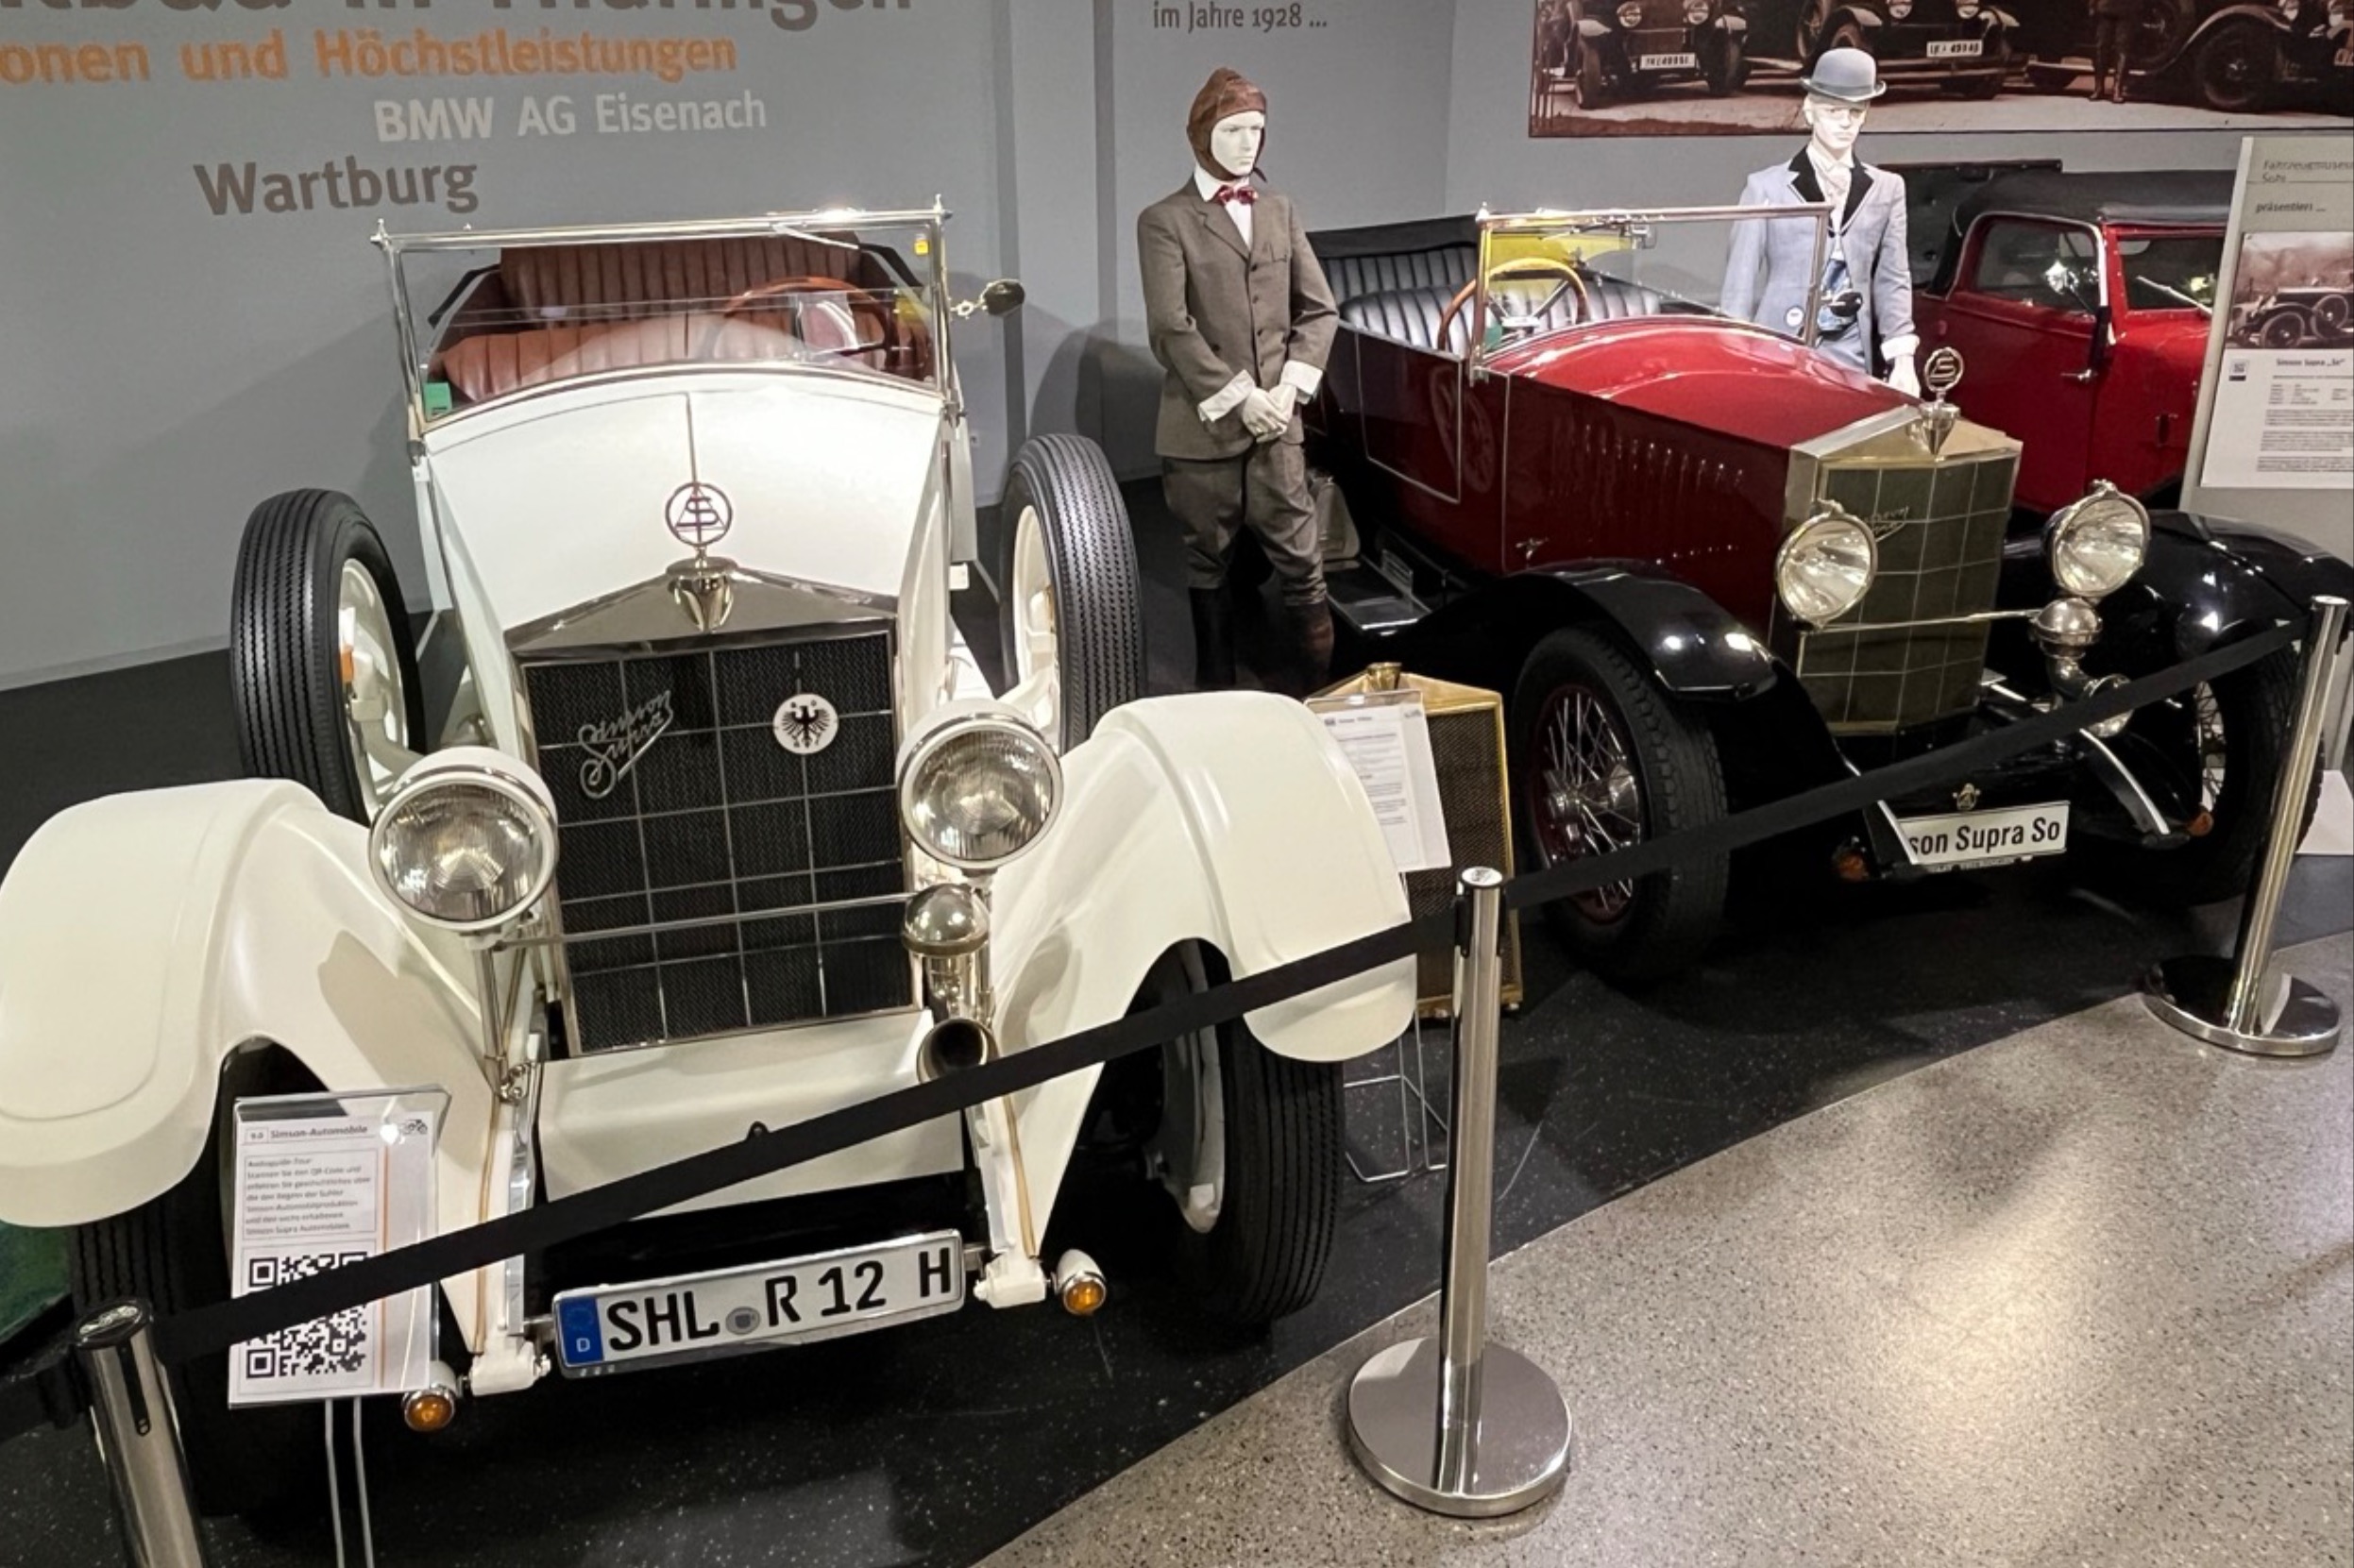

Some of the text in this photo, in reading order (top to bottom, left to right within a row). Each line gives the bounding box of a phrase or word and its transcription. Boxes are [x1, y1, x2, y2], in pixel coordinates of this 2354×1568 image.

[1153, 0, 1180, 29] im
[1188, 0, 1245, 34] Jahre
[1252, 3, 1303, 33] 1928
[0, 25, 737, 85] onen und Höchstleistungen
[375, 90, 767, 143] BMW AG Eisenach
[194, 155, 479, 215] Wartburg
[1956, 824, 2024, 853] Supra
[2031, 817, 2060, 843] So
[605, 1247, 951, 1352] SHL R 12 H
[577, 1338, 591, 1353] D
